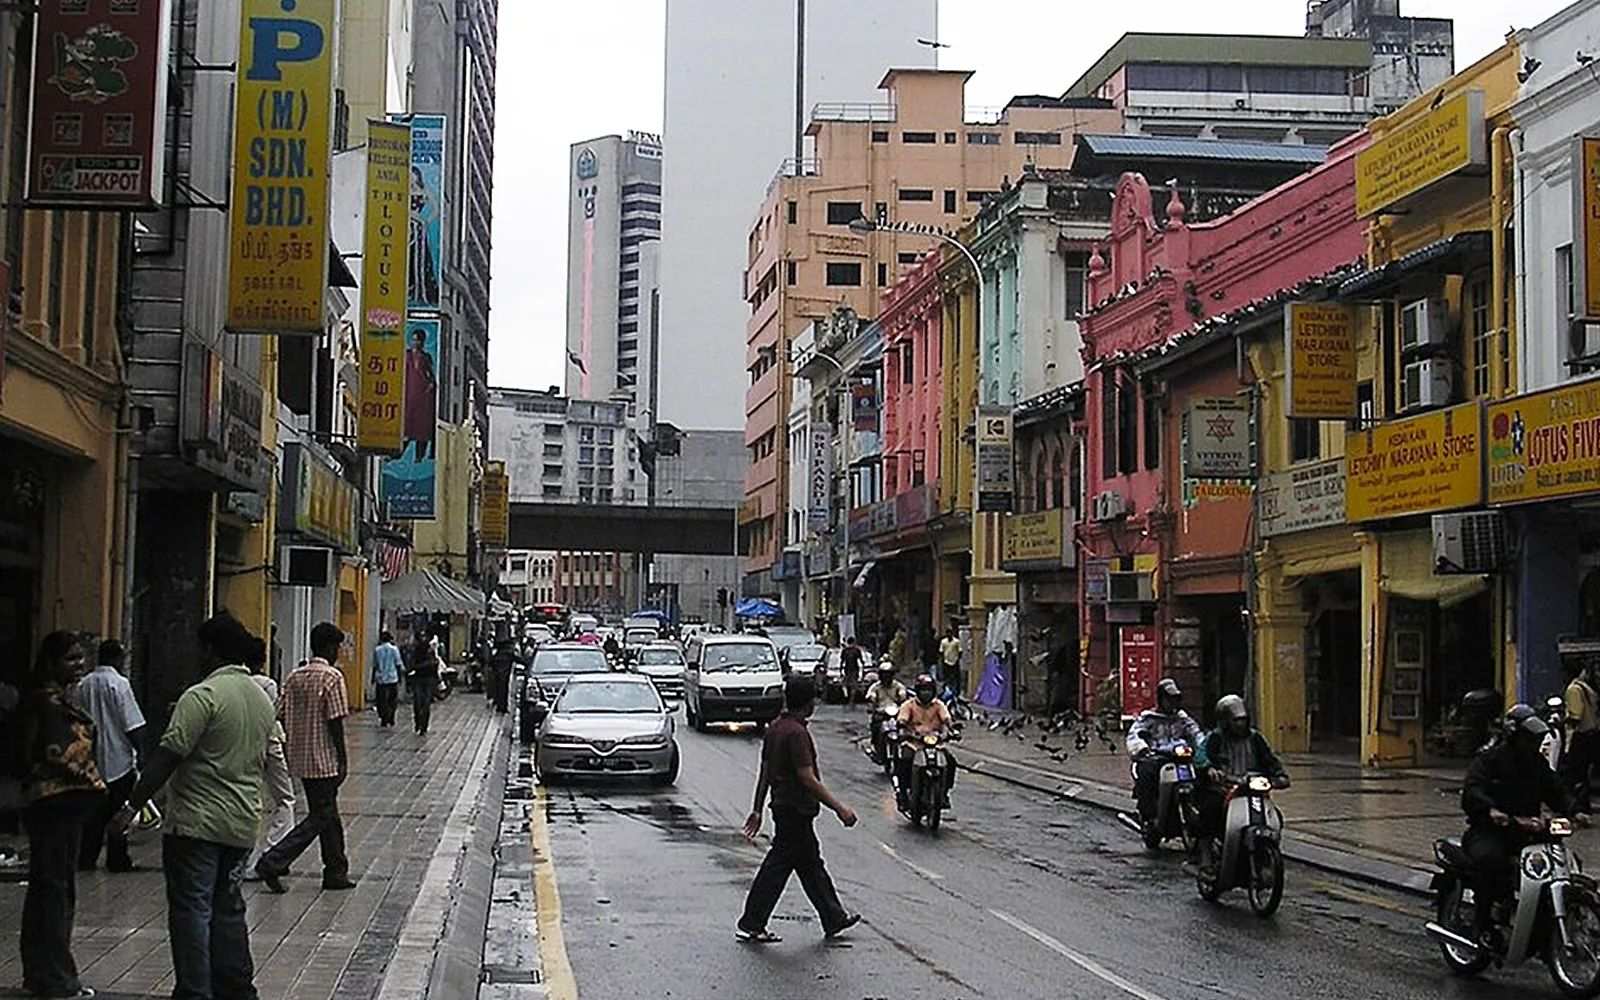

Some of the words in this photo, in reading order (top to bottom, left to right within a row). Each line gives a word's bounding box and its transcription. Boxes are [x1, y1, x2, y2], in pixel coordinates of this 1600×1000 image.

[257, 89, 309, 130] (M)
[250, 138, 313, 178] SDN.
[75, 172, 140, 191] JACKPOT
[371, 189, 404, 201] THE
[245, 186, 313, 226] BHD.
[379, 204, 393, 296] LOTUS
[1307, 353, 1340, 367] STORE
[1390, 442, 1438, 467] NARAYANA
[1443, 433, 1475, 458] STORE
[1527, 424, 1568, 467] LOTUS
